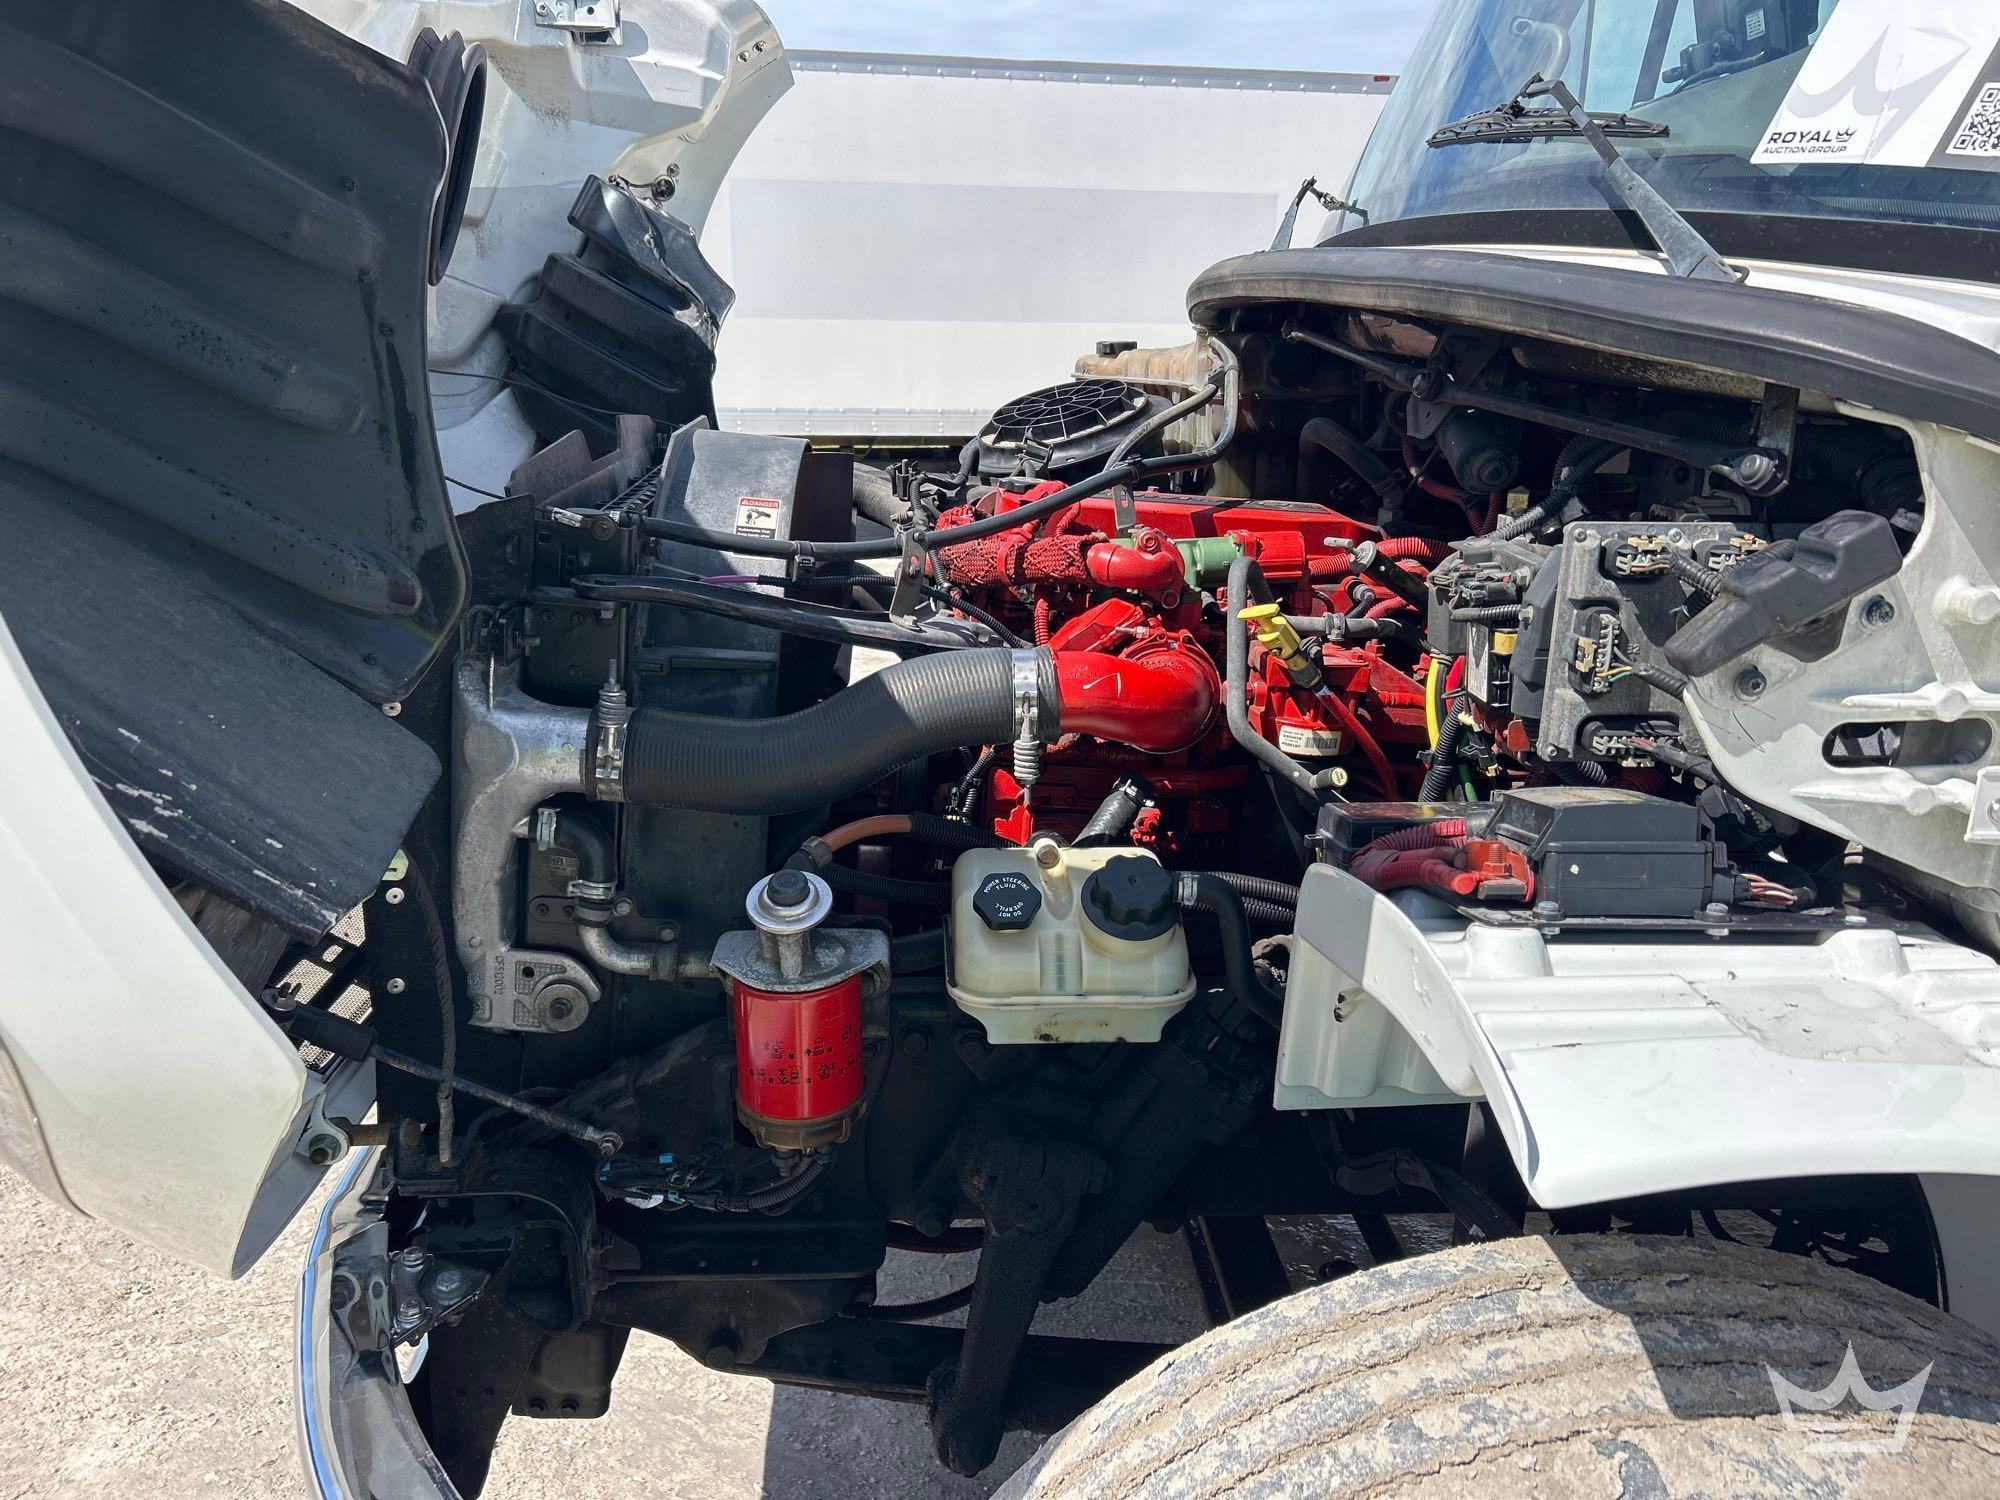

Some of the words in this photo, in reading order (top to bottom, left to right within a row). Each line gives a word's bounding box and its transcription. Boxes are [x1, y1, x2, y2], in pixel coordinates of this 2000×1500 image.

[1767, 130, 1832, 144] ROYAL
[1762, 146, 1807, 154] AUCTION
[1808, 145, 1847, 153] GROUP
[984, 879, 1000, 893] POWER
[1002, 877, 1030, 891] STEERING
[996, 882, 1017, 890] FLUID
[995, 901, 1024, 912] OVERFILL
